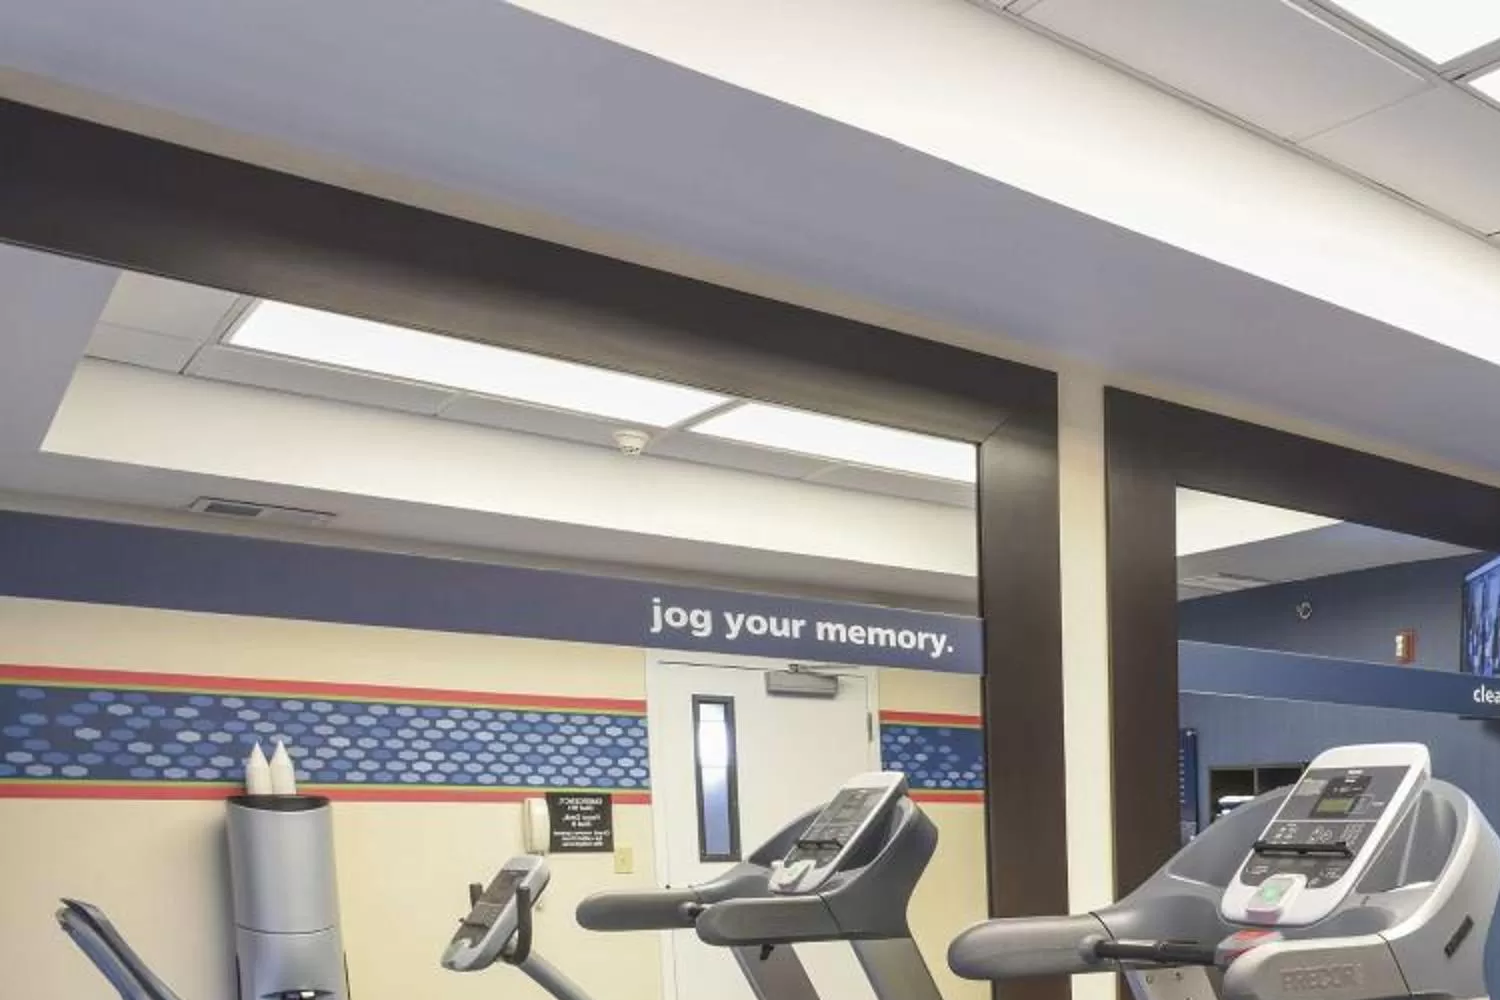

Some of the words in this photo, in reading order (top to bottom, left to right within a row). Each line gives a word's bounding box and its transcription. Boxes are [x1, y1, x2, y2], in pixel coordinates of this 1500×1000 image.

[650, 597, 713, 638] jog
[723, 611, 806, 640] your
[815, 619, 954, 658] memory.
